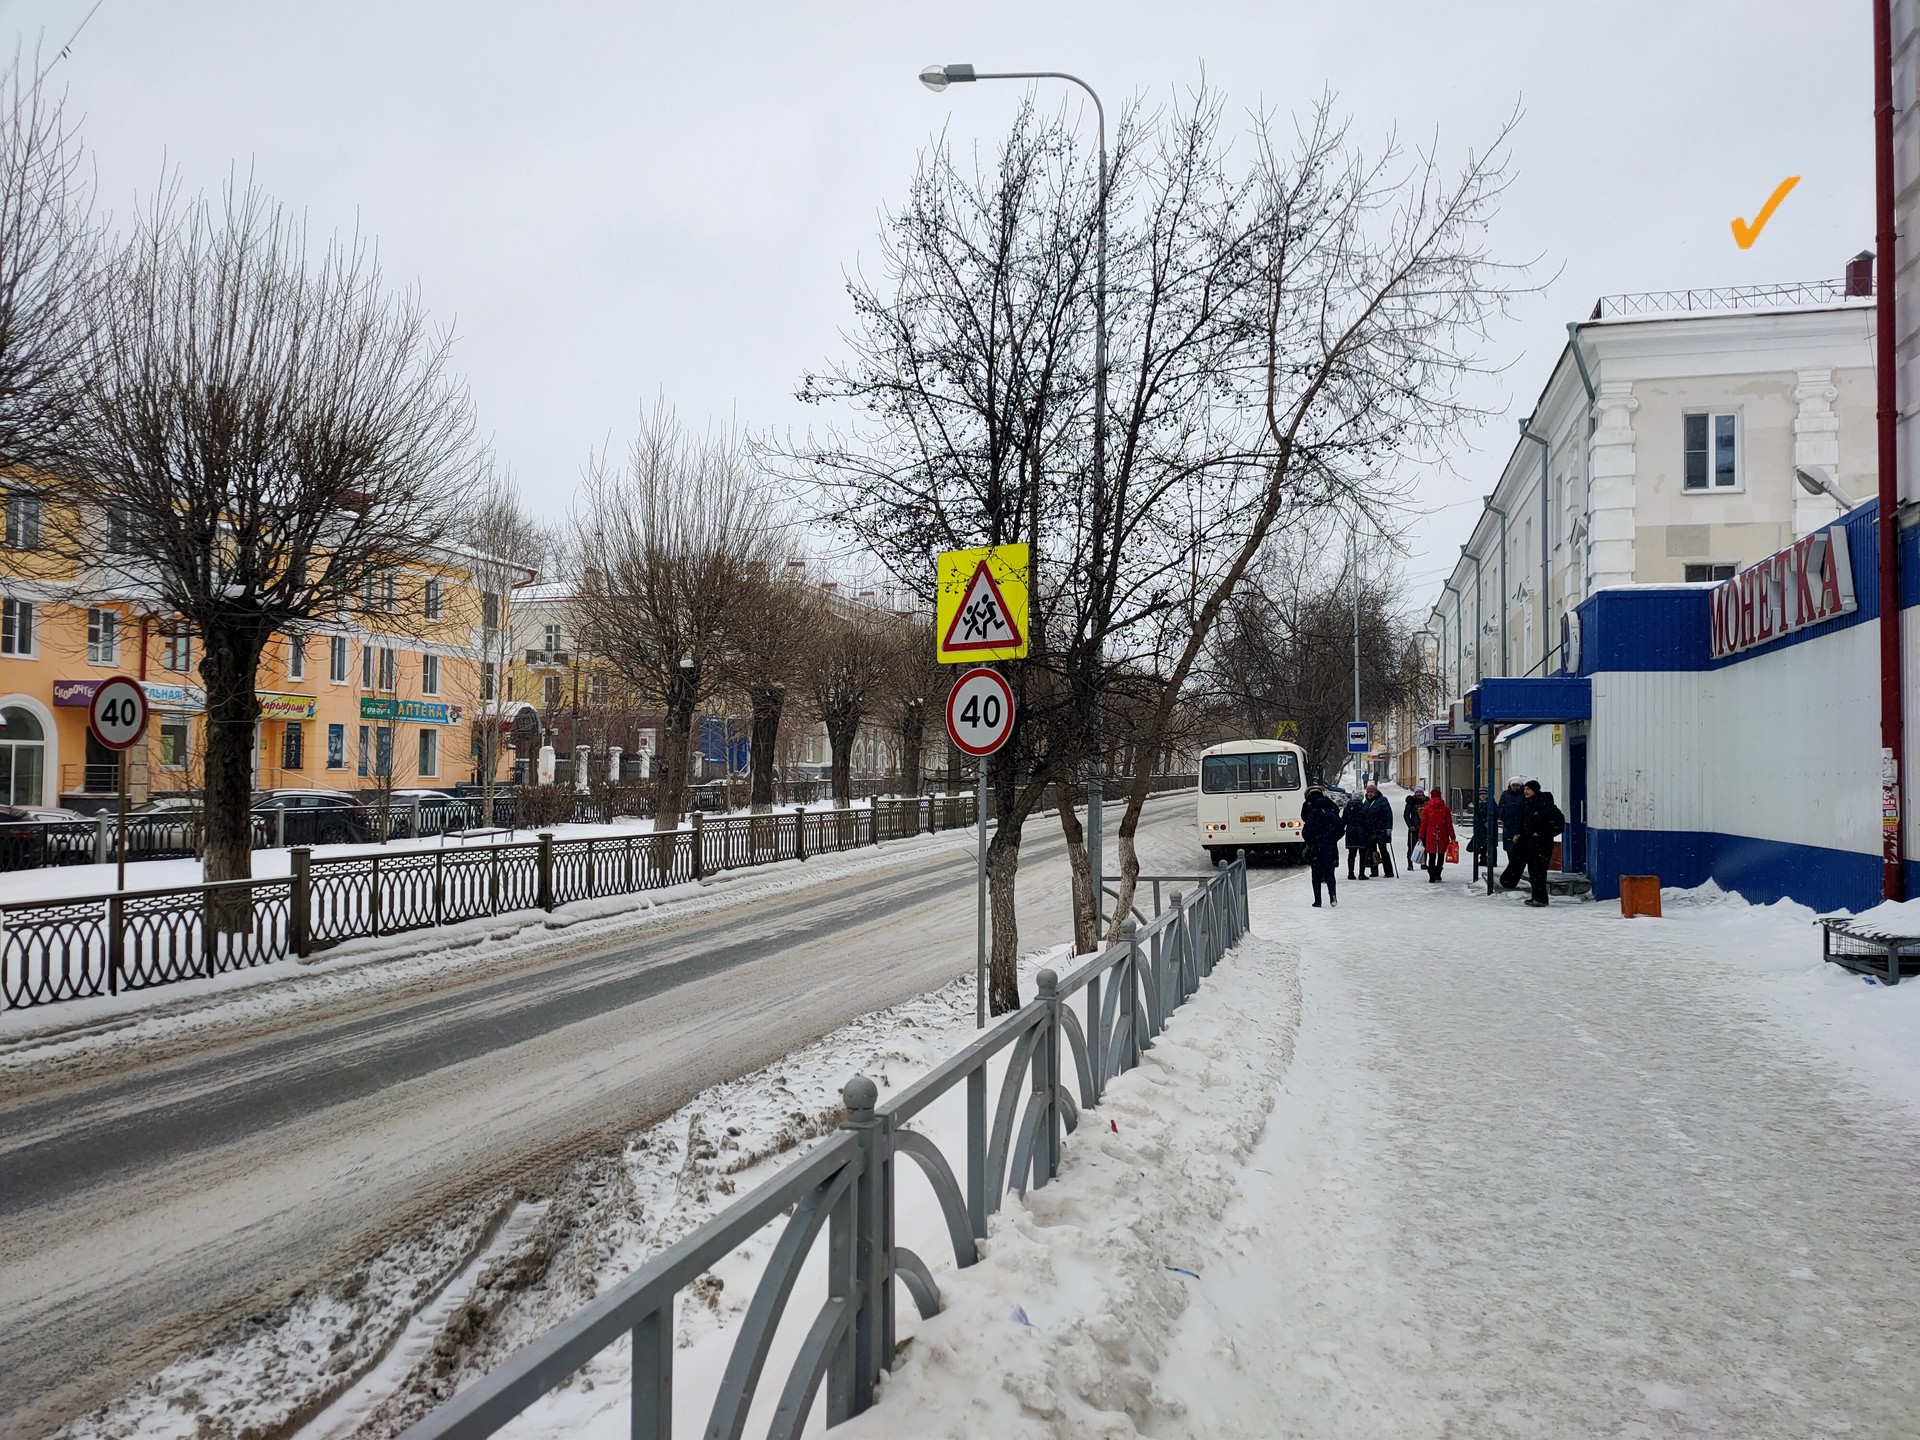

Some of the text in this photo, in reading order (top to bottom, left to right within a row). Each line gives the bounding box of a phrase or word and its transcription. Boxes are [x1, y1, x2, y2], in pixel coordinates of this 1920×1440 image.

[1709, 527, 1844, 658] МОНЕТКА
[101, 699, 136, 727] 40
[398, 703, 443, 718] АПТЕКА
[960, 695, 1001, 728] 40
[1278, 755, 1287, 764] 23
